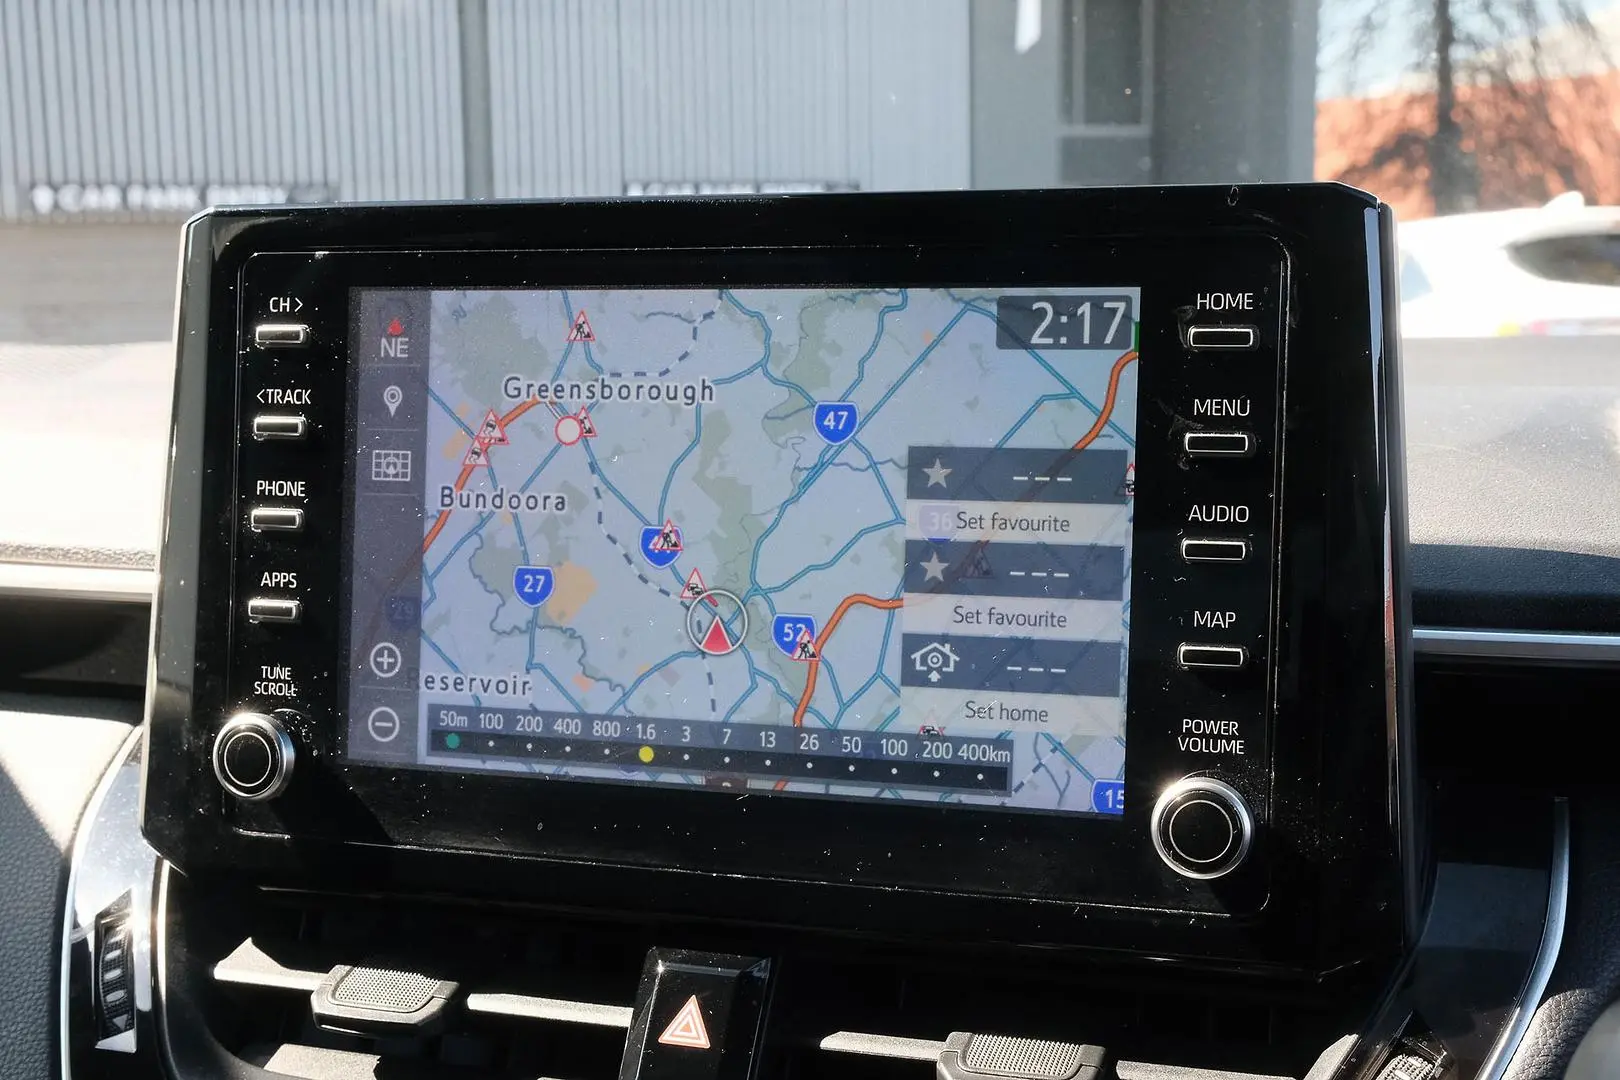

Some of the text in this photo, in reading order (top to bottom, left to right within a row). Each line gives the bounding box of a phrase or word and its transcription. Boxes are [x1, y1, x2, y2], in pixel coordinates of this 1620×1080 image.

[269, 297, 290, 313] CH
[1196, 293, 1254, 310] HOME
[1030, 302, 1127, 345] 2:17
[380, 337, 409, 358] NE
[503, 376, 714, 406] Greensborough
[1193, 399, 1250, 416] MENU
[823, 411, 849, 431] 47
[256, 480, 306, 497] PHONE
[440, 486, 566, 511] Bundoora
[956, 511, 1071, 532] Set favourite
[1188, 504, 1250, 523] AUDIO
[260, 571, 298, 588] APPS
[523, 575, 545, 593] 27
[952, 605, 1068, 628] Set favourite
[1193, 610, 1237, 629] MAP
[261, 665, 292, 681] TUNE
[254, 681, 298, 697] SCROLL
[965, 701, 1049, 723] Set home
[439, 710, 468, 728] 50m
[478, 712, 504, 730] 100
[516, 715, 543, 733] 200
[553, 718, 582, 736] 400
[592, 721, 621, 738] 800
[682, 726, 692, 743] 3
[722, 728, 732, 746] 7
[759, 731, 777, 748] 13
[800, 734, 820, 751] 26
[842, 736, 862, 754] 50
[880, 738, 908, 757] 100
[922, 740, 953, 760] 200
[957, 743, 1011, 763] 400km
[1182, 718, 1239, 736] POWER
[1177, 735, 1245, 755] VOLUME
